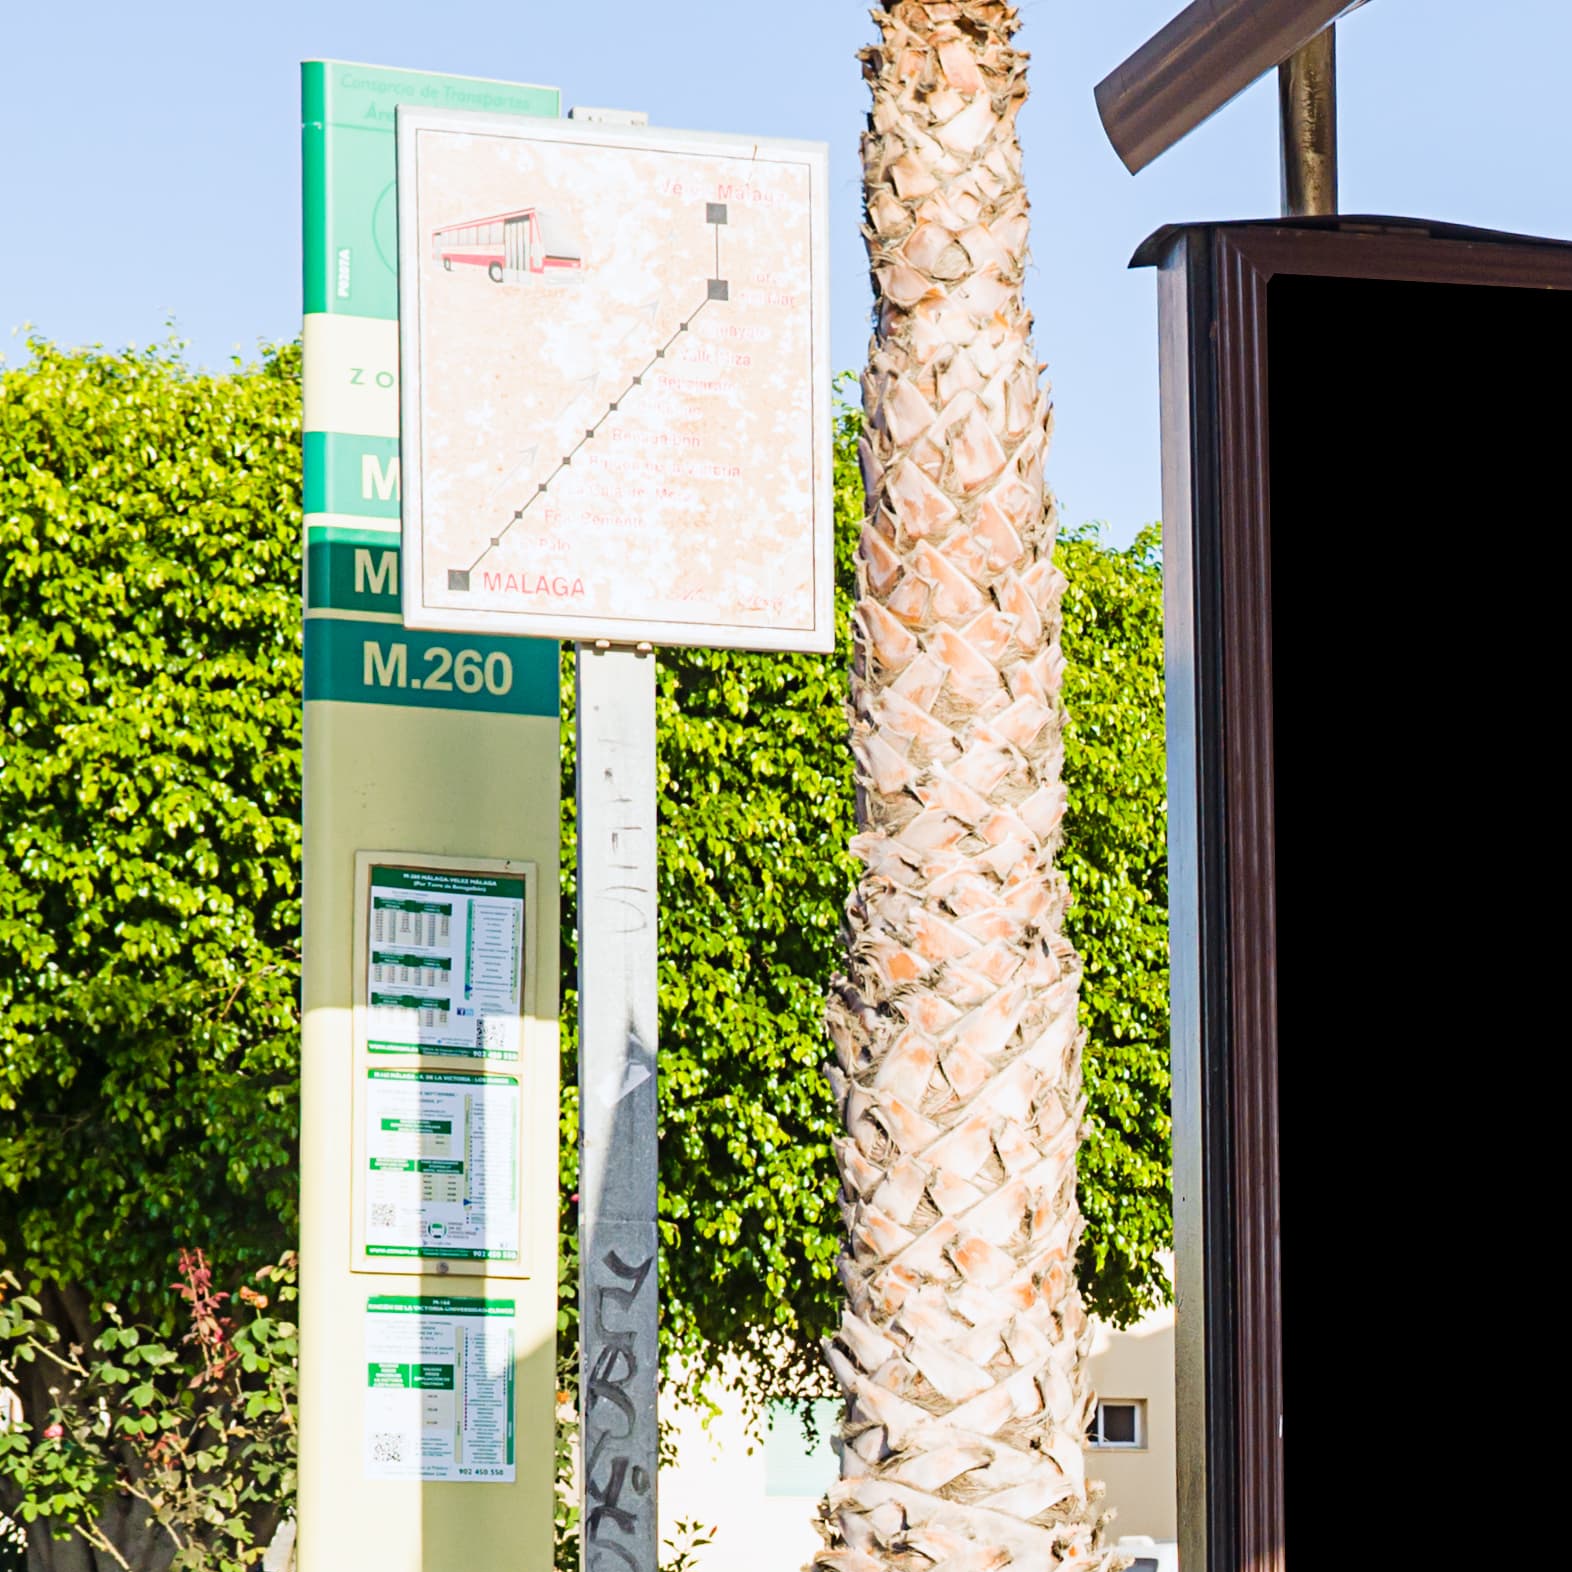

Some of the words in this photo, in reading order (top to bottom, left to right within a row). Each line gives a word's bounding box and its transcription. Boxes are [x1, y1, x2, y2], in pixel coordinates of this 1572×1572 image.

[341, 73, 414, 98] Consorcio
[419, 83, 439, 100] de
[442, 86, 531, 111] Transportes
[483, 571, 586, 598] MALAGA
[363, 641, 513, 695] M.260
